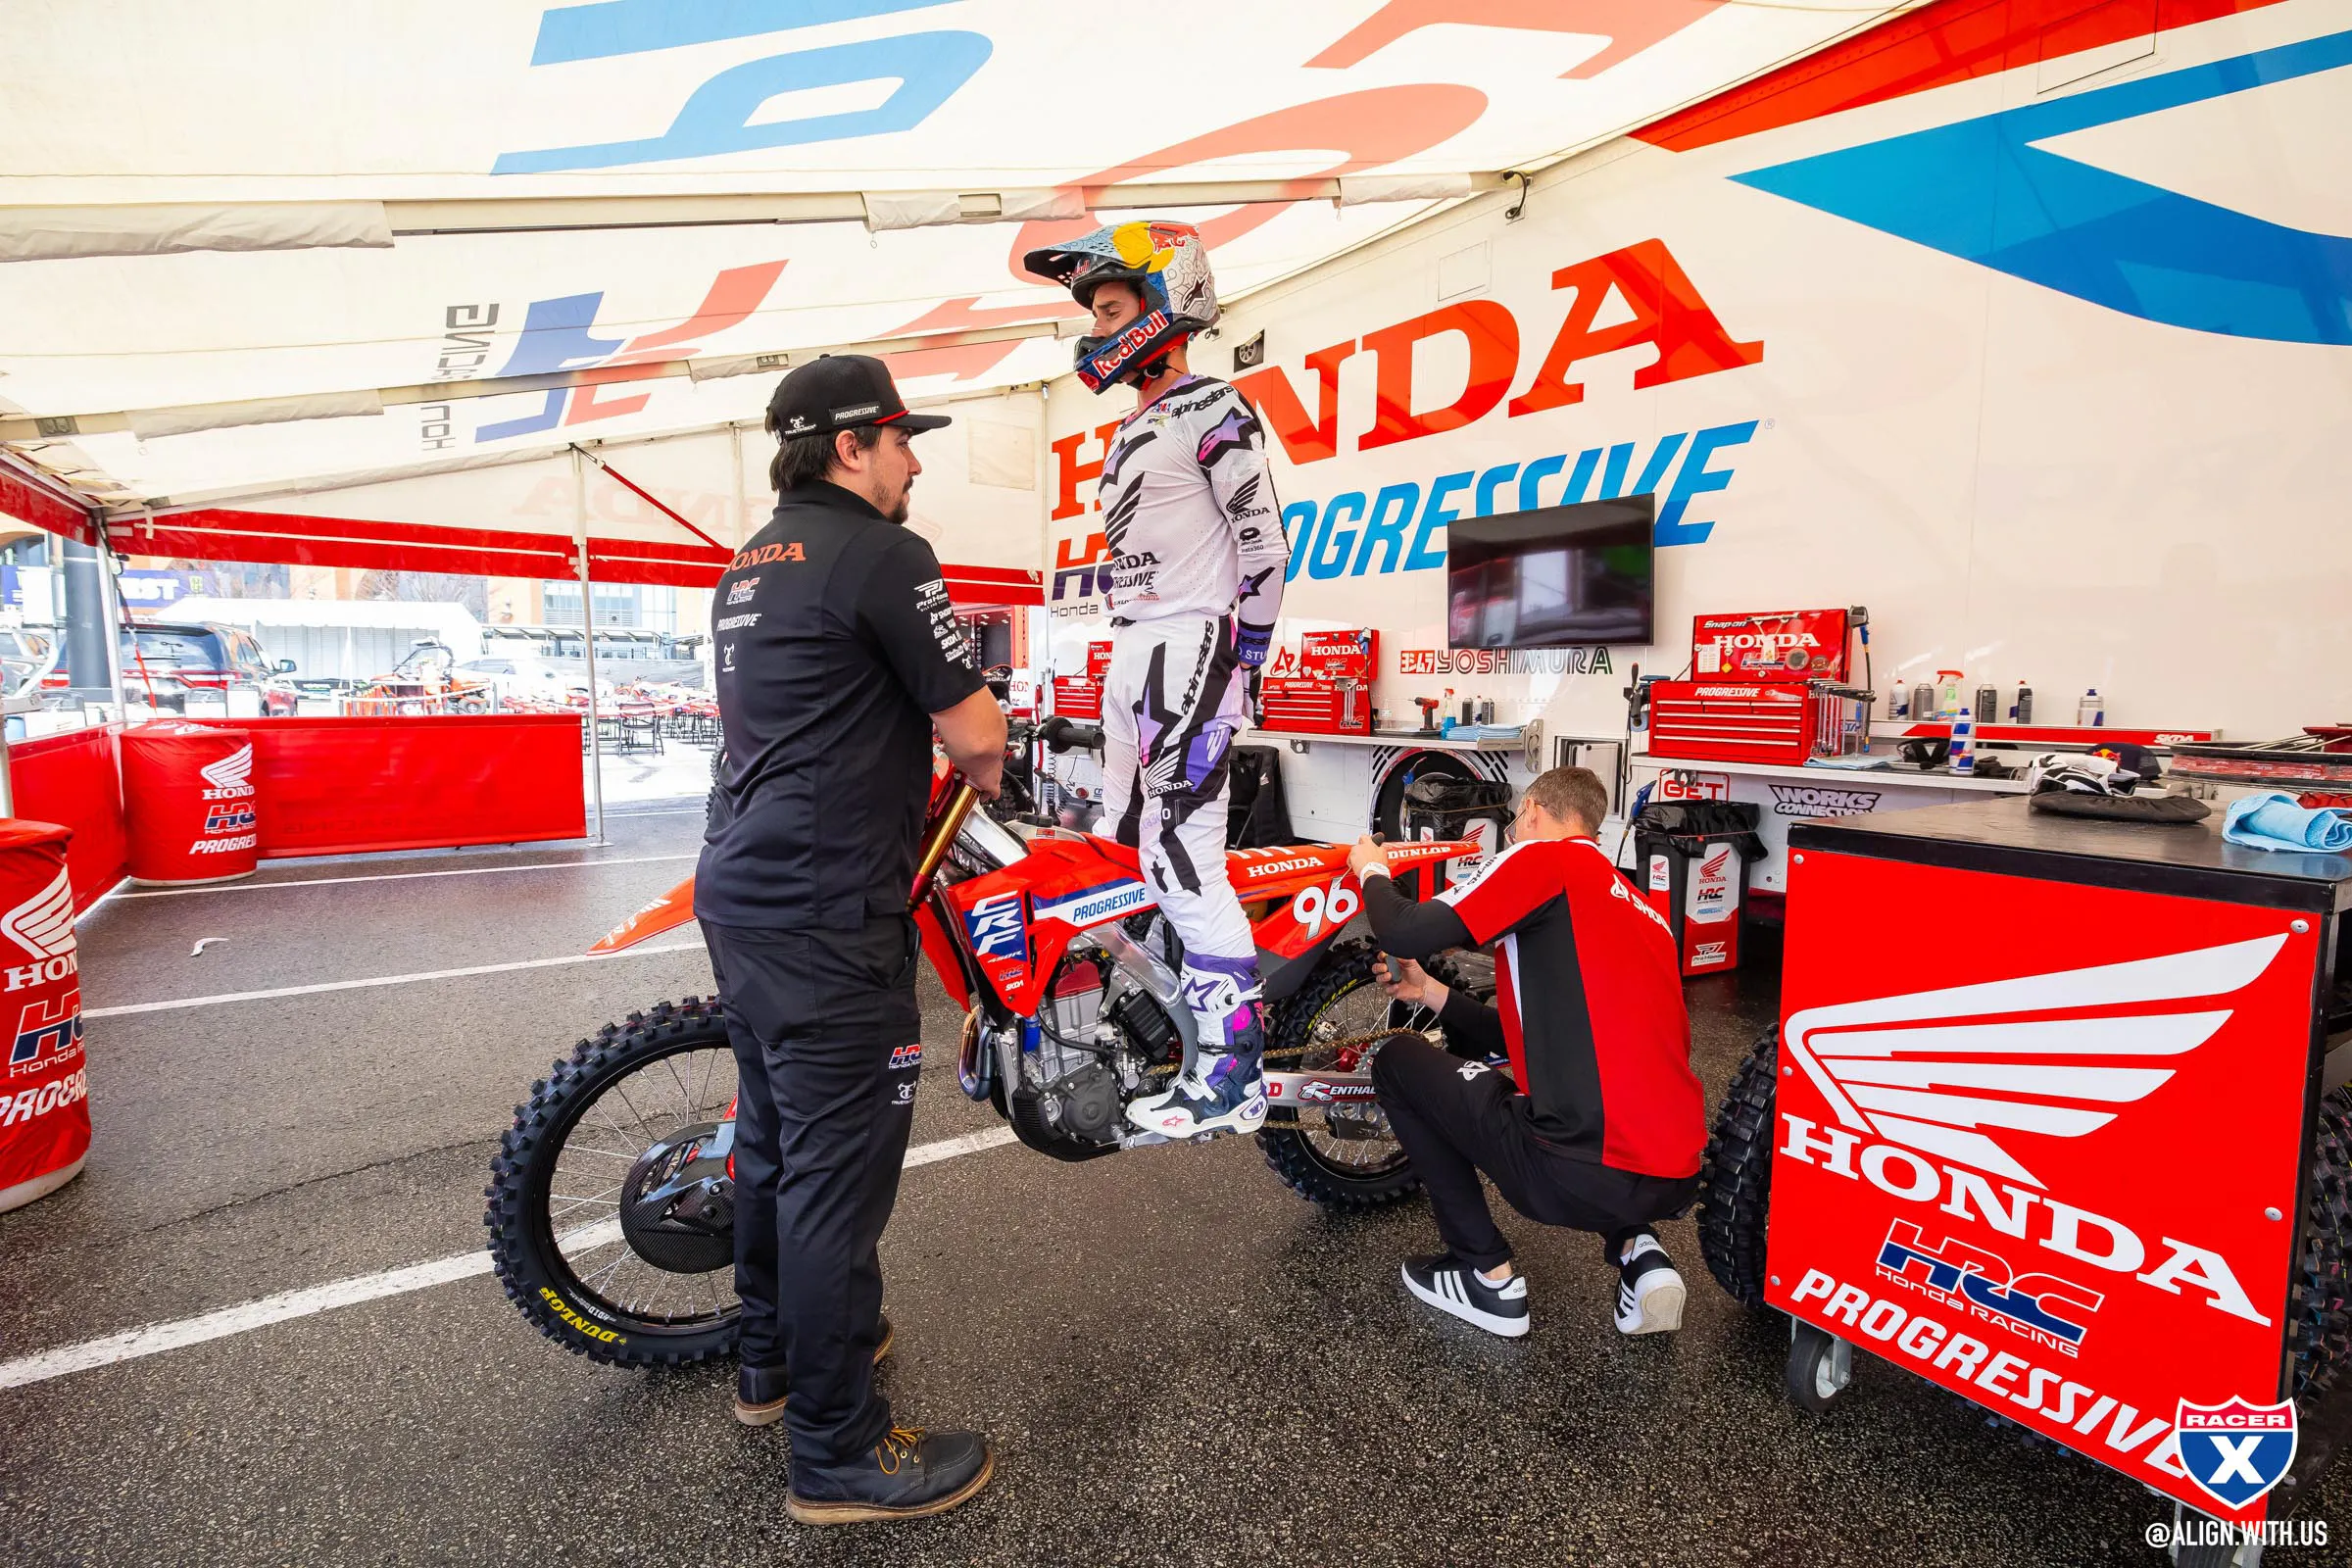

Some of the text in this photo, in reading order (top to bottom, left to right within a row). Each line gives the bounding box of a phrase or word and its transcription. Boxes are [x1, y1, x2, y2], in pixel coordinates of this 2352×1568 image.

[1052, 238, 1764, 520] HNDA
[835, 406, 879, 421] PROGRESSIVE
[1171, 385, 1234, 419] alpinestars
[1051, 603, 1098, 618] Honda
[1703, 620, 1747, 629] Snap-on
[1311, 645, 1361, 656] HONDA
[1400, 650, 1435, 674] ヨシムラ
[1437, 646, 1613, 675] YOSHIMURA
[1181, 620, 1214, 715] alpinestars
[1694, 687, 1760, 698] PROGRESSIVE
[1150, 779, 1194, 799] HONDA
[1663, 780, 1724, 800] GET
[1769, 785, 1881, 809] WORKS
[1388, 845, 1451, 860] DUNLOP
[1248, 856, 1325, 878] HONDA
[1698, 876, 1728, 885] HONDA
[1073, 887, 1146, 922] PROGRESSIVE
[1697, 887, 1725, 902] HRC
[1293, 876, 1359, 942] 96
[970, 890, 1022, 956] CRF
[1004, 979, 1024, 992] SKDA
[1780, 1112, 2272, 1327] HONDA
[1876, 1217, 2105, 1347] HRC
[539, 1286, 619, 1343] DUNLOP
[1875, 1266, 2080, 1359] Honda RACING
